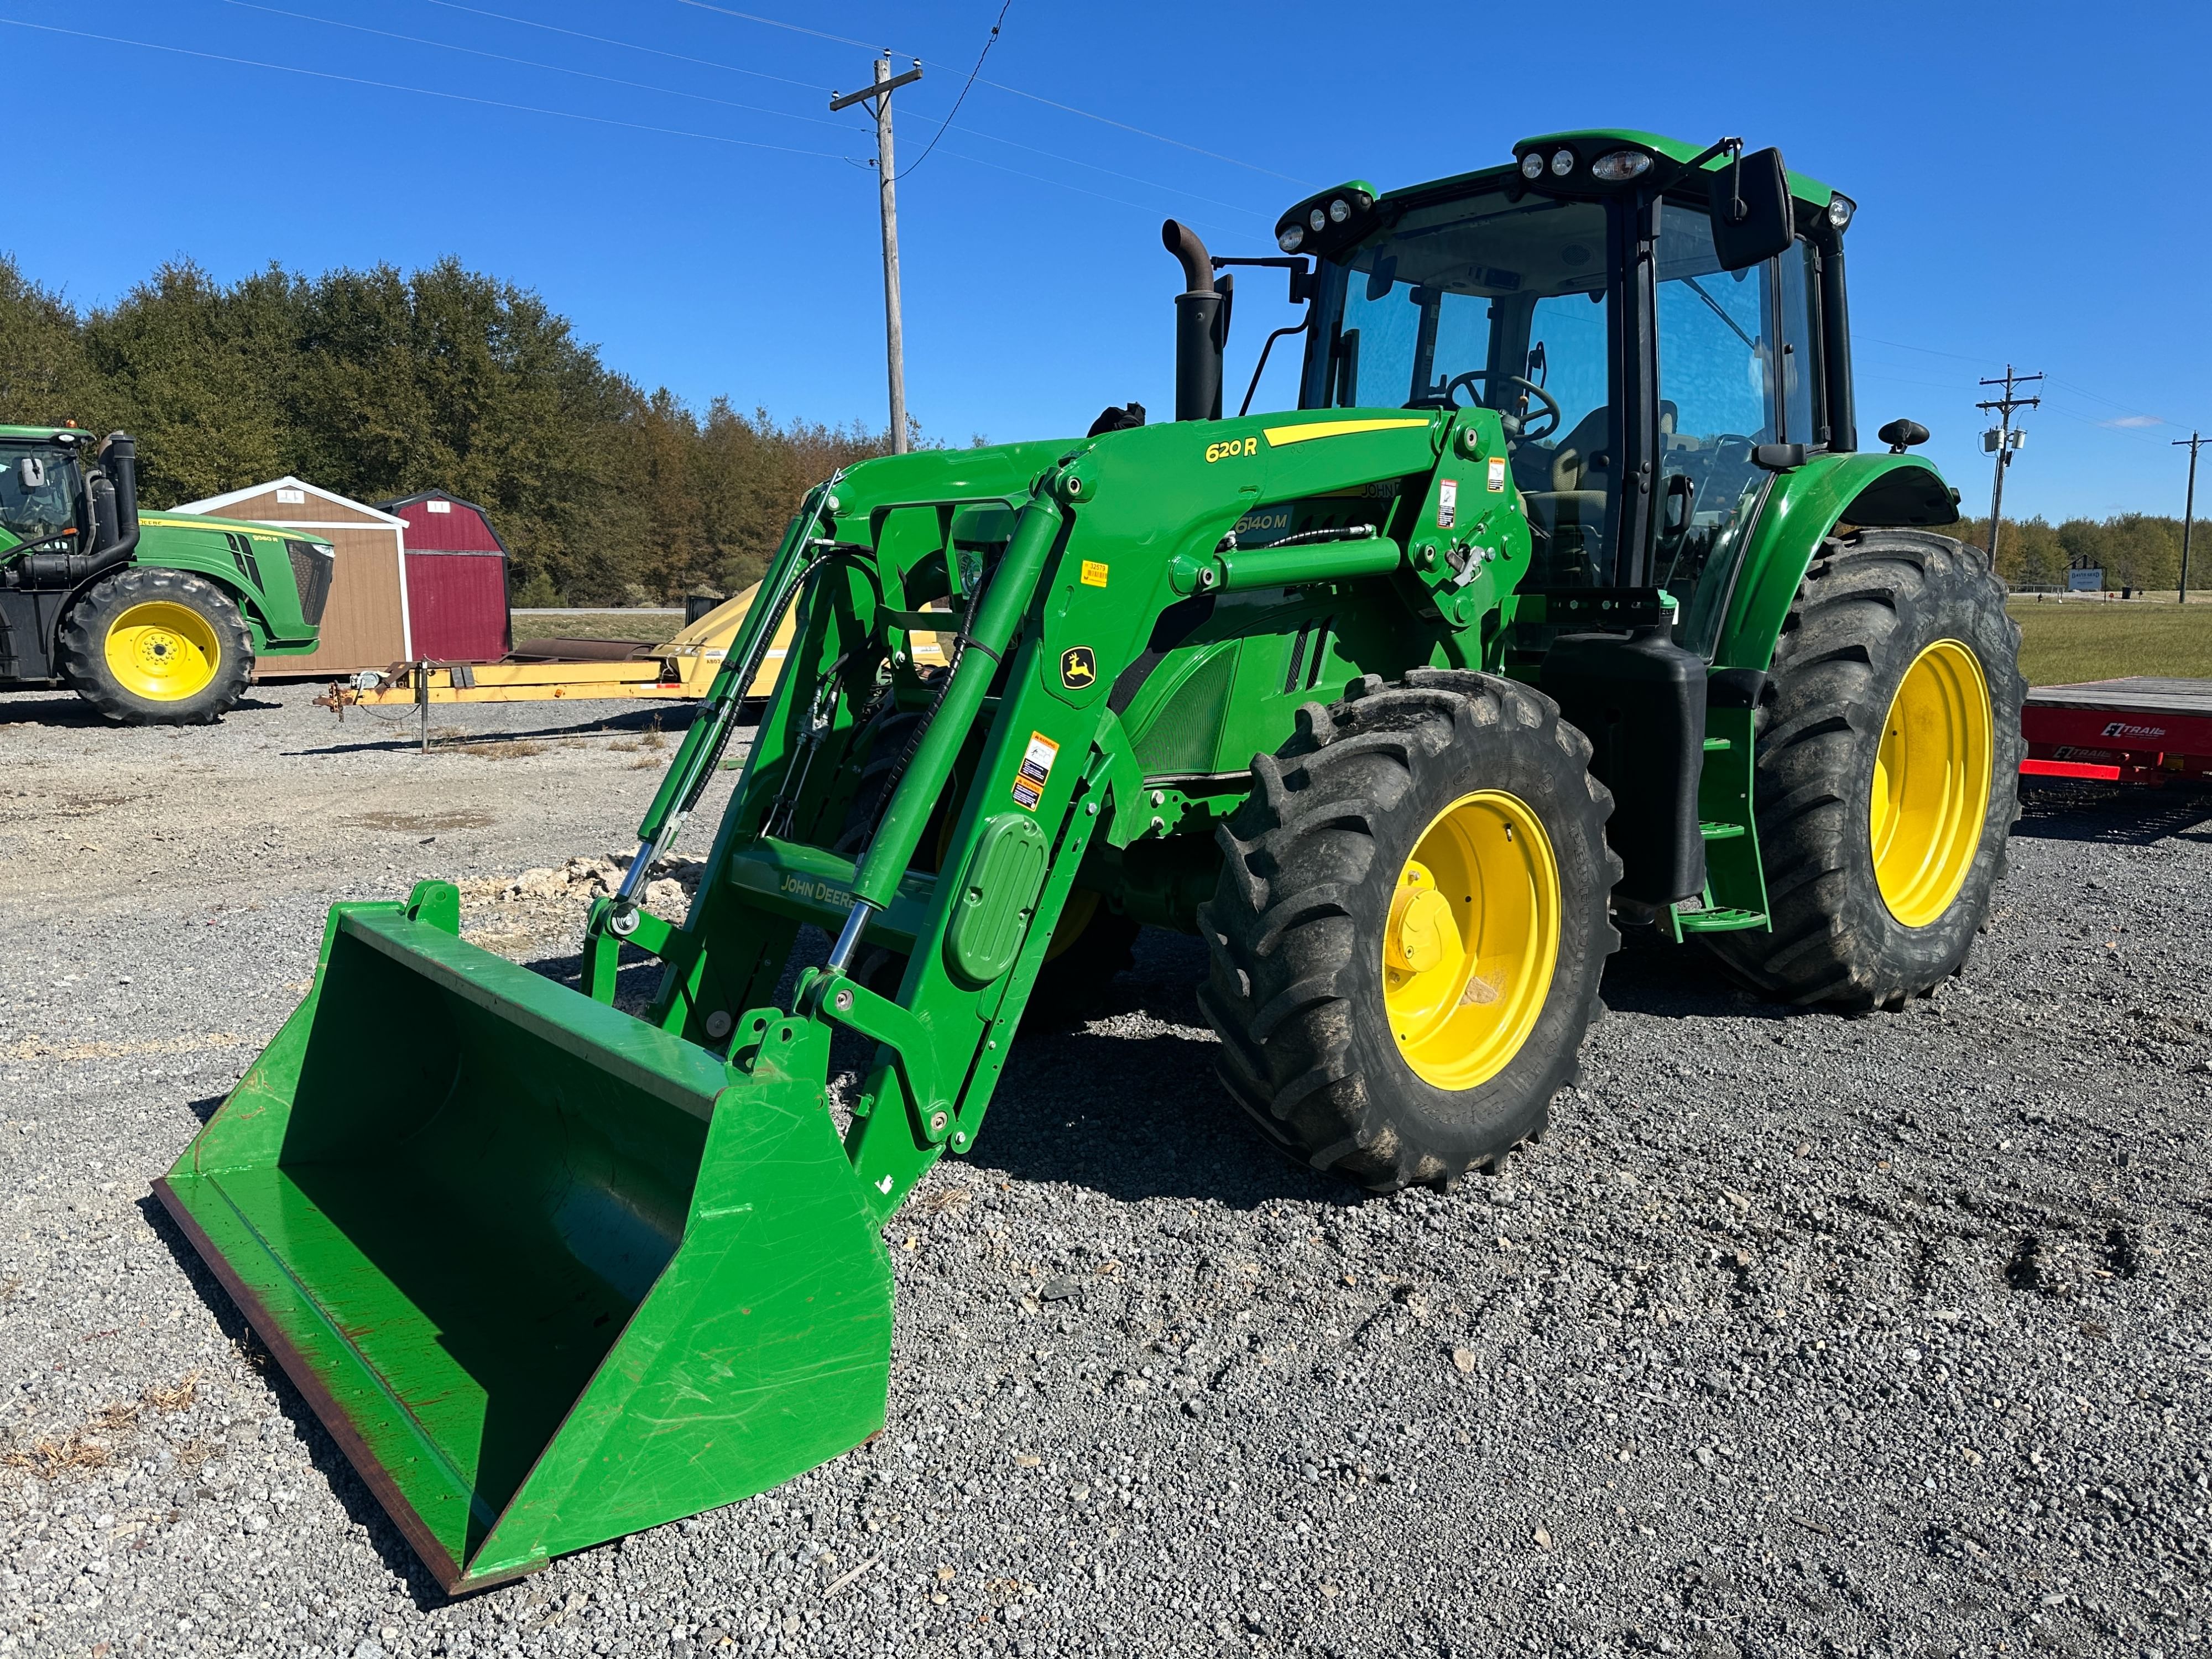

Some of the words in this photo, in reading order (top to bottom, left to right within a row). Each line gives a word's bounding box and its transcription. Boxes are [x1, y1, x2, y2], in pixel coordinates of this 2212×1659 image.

[1205, 440, 1241, 463] 620
[1244, 436, 1258, 457] R
[1361, 484, 1392, 496] JOHN
[1235, 515, 1272, 534] 6140
[1274, 514, 1288, 529] M
[2123, 726, 2165, 735] TRAIL
[780, 874, 815, 898] JOHN
[815, 882, 857, 909] DEERE
